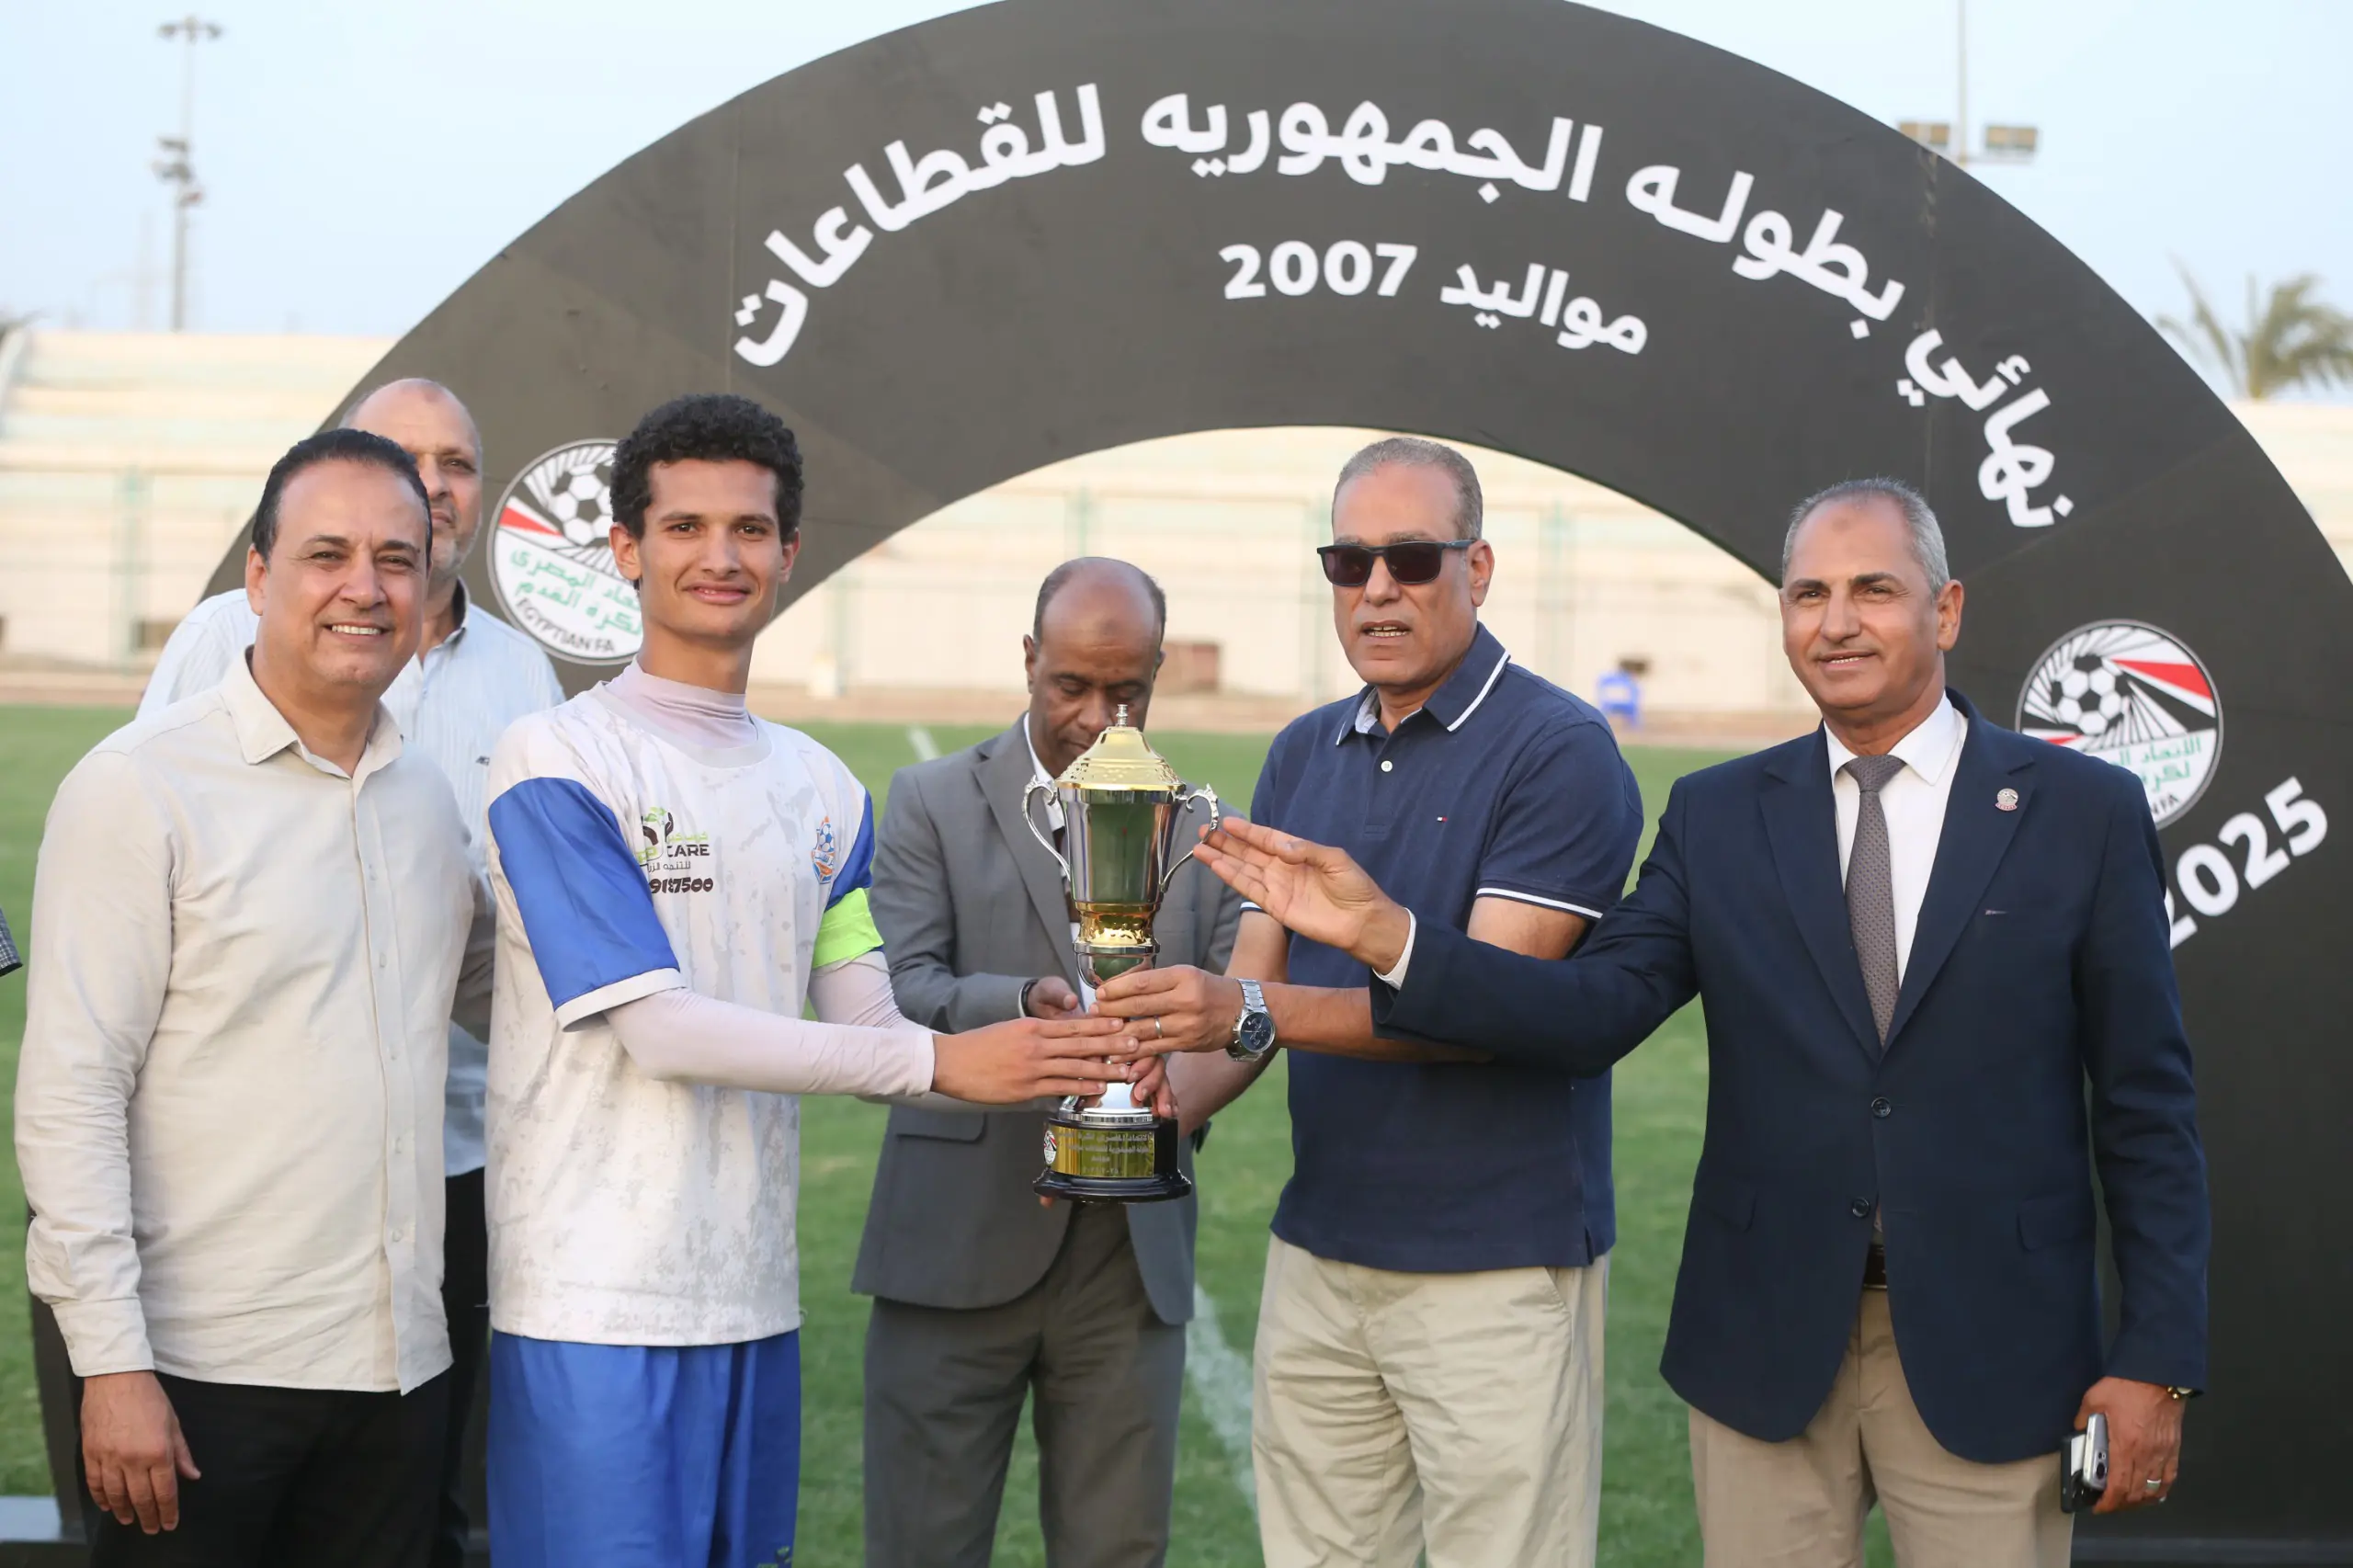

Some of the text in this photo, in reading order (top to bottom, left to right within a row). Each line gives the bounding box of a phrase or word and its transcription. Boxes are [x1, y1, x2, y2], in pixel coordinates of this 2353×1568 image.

[1142, 94, 1602, 203] الجمهوريه
[734, 84, 1105, 366] للقطاعات
[1220, 241, 1646, 354] مواليد 2007
[1905, 330, 2073, 527] نهائي
[517, 597, 590, 651] EGYPTIAN
[595, 638, 615, 652] FA
[666, 844, 710, 858] CARE
